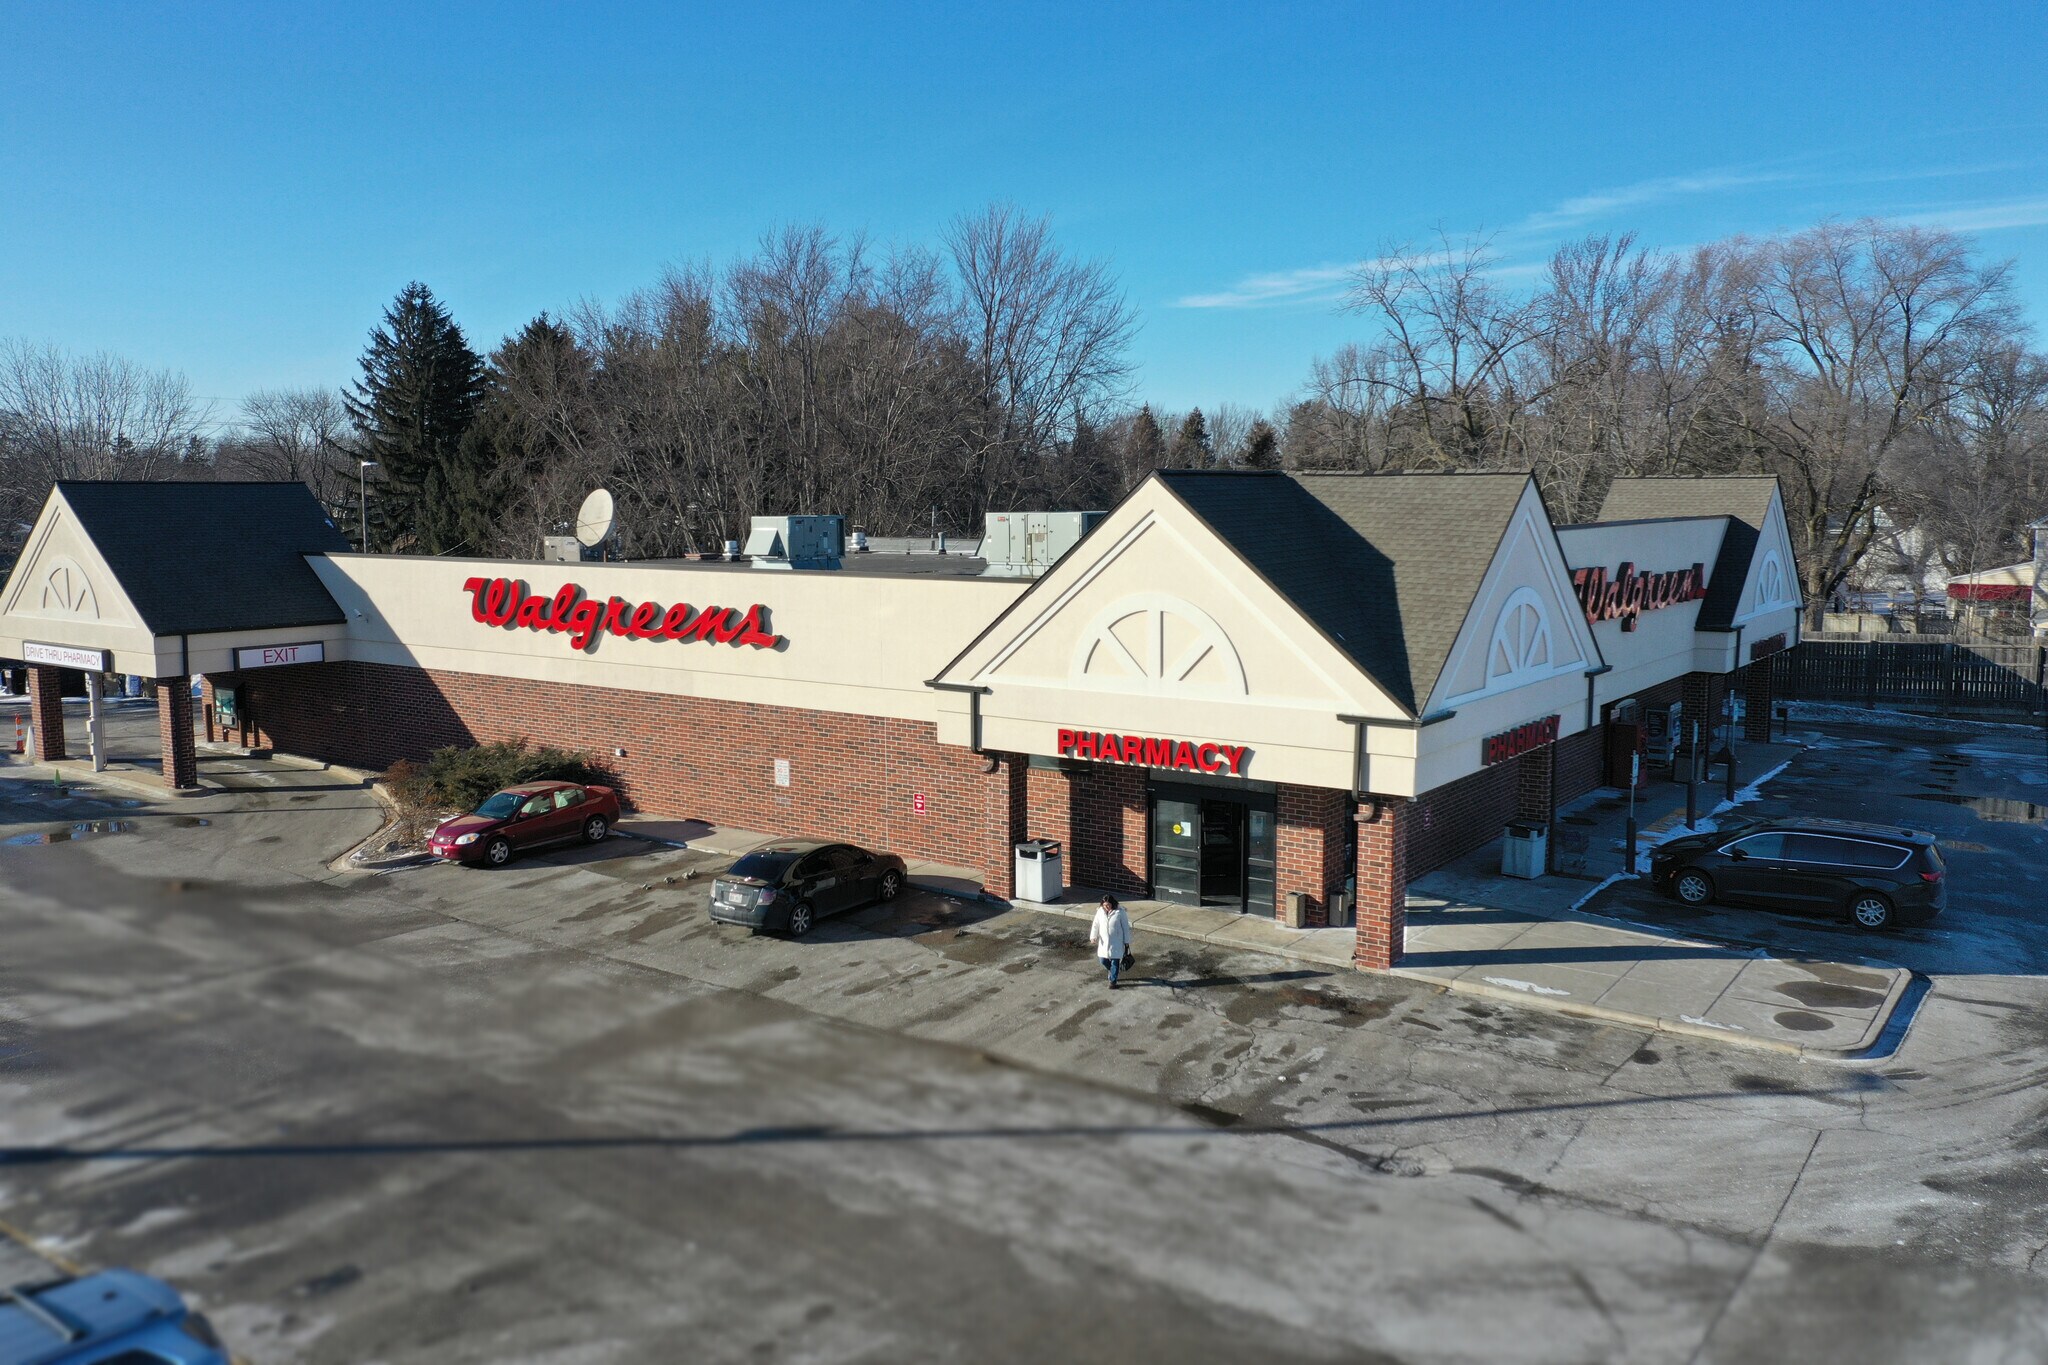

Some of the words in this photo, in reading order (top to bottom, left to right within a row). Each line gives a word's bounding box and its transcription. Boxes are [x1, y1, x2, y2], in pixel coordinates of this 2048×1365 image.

[463, 577, 778, 650] Walgreens
[1572, 562, 1707, 632] Walgreens
[26, 646, 43, 659] DRIVE
[45, 648, 62, 662] THRU
[63, 651, 101, 667] PHARMACY
[263, 647, 299, 664] EXIT
[1058, 729, 1247, 774] PHARMACY
[1484, 714, 1561, 766] PHARMACY
